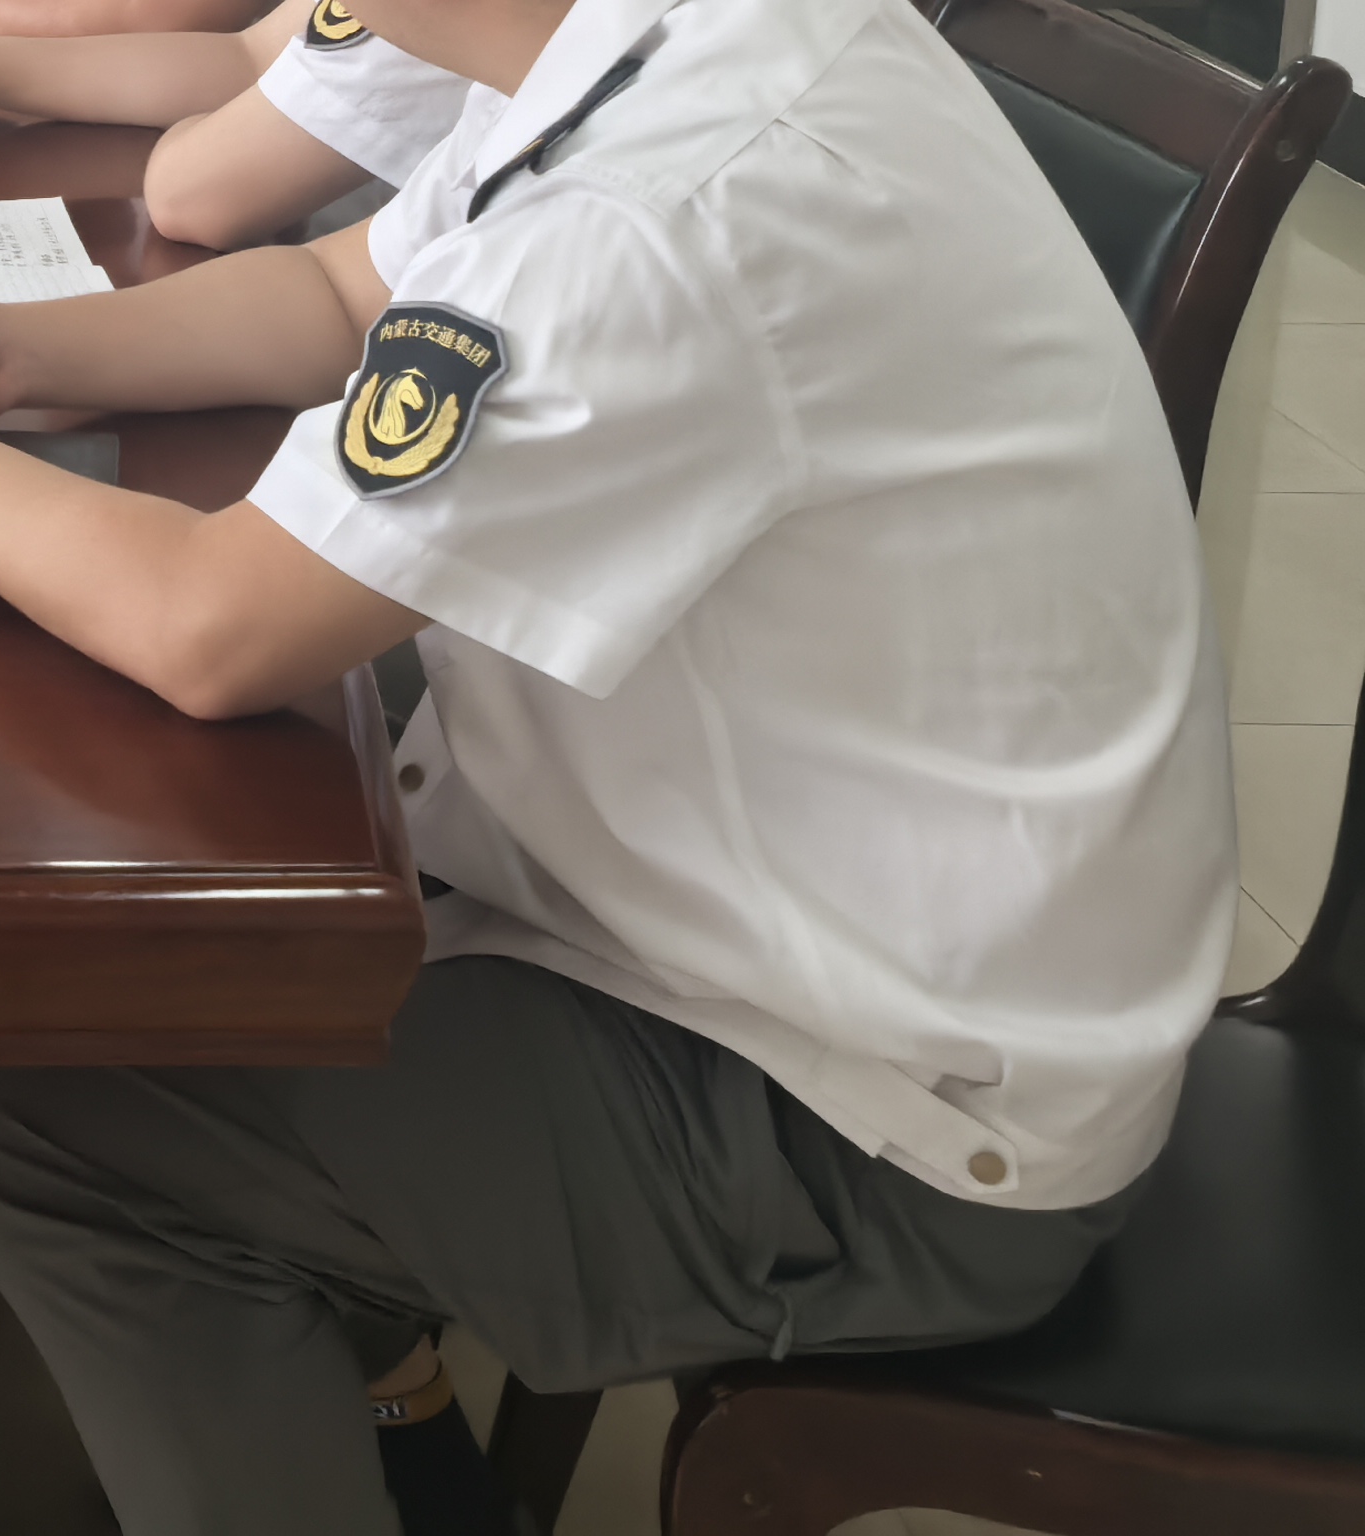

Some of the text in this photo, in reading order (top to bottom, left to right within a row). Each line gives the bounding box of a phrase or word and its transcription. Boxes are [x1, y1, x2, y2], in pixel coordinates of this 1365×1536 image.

[379, 318, 492, 368] 内蒙古交通集团
